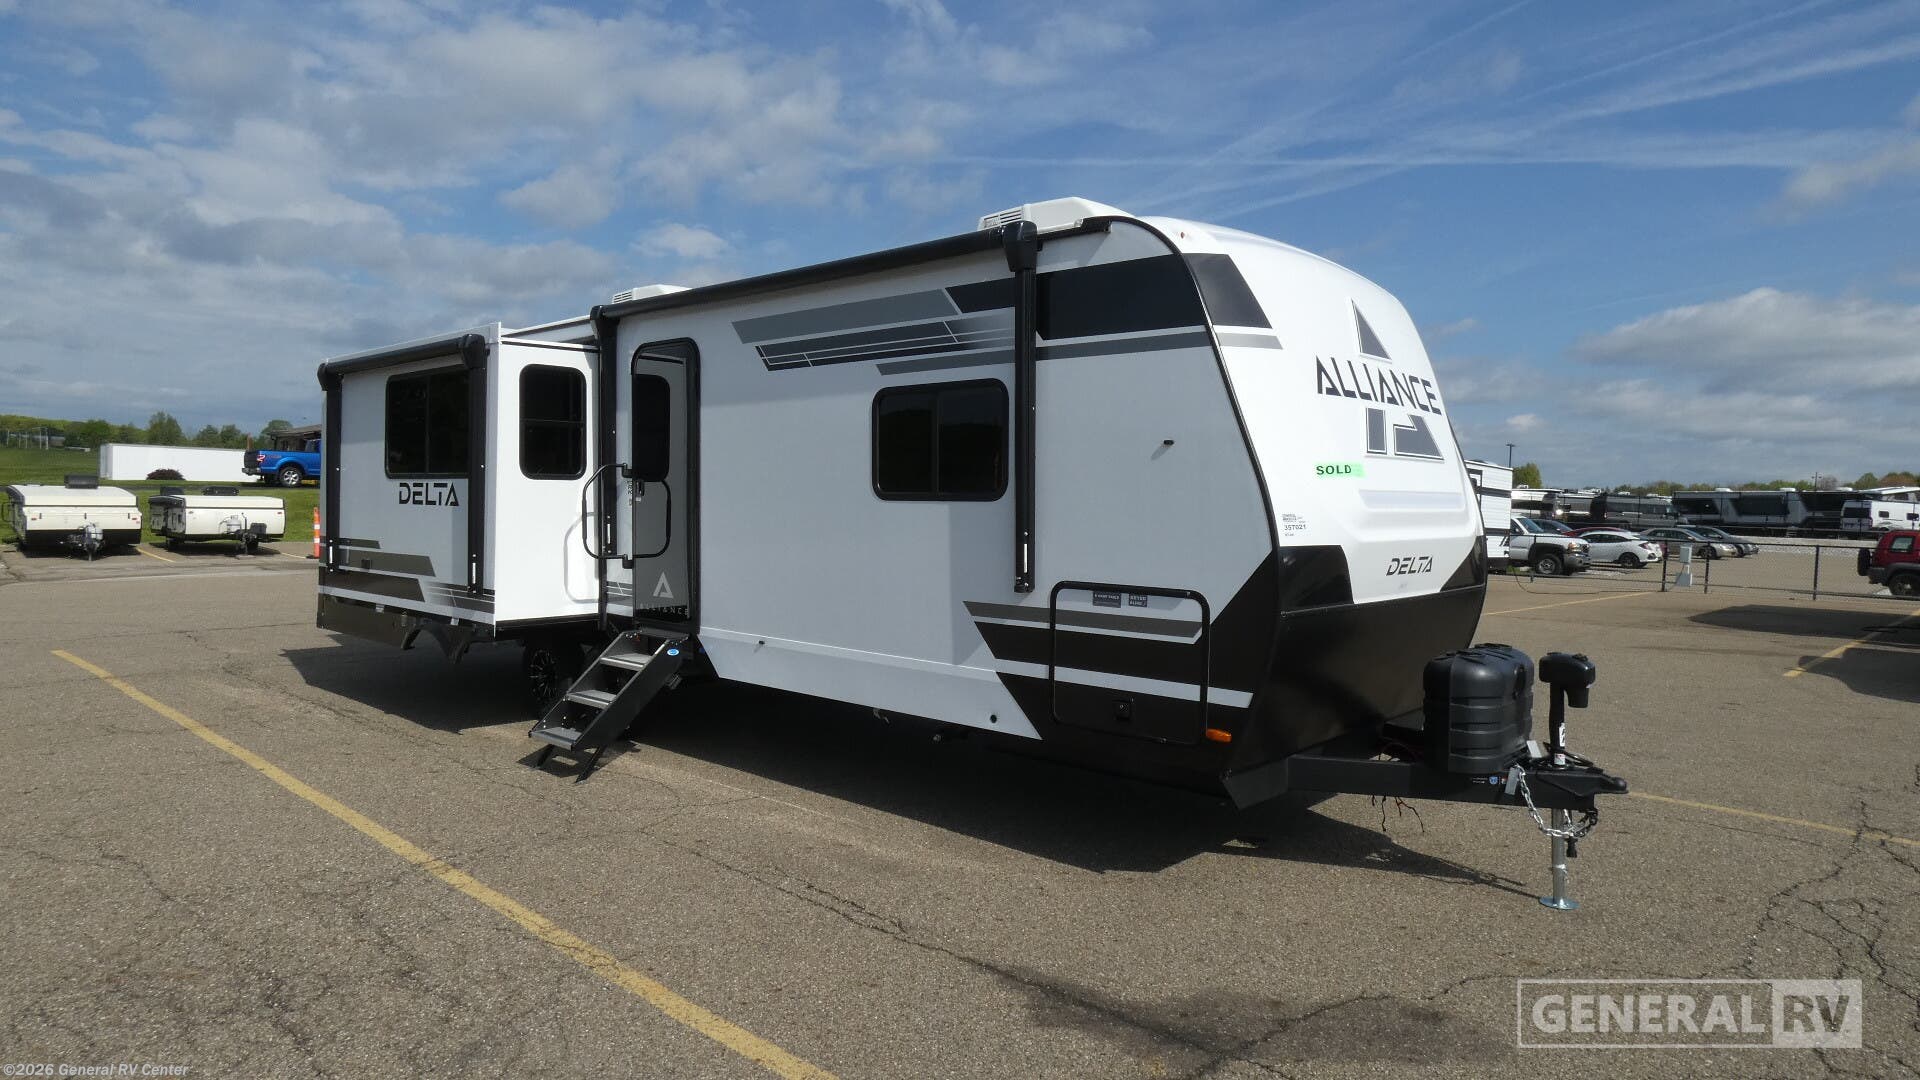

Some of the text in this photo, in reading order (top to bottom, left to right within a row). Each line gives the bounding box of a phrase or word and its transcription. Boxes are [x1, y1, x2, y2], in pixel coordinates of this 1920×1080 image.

[1316, 356, 1441, 415] ALLIANCE
[1316, 464, 1352, 476] SOLD
[399, 482, 460, 507] DELTA
[1386, 556, 1433, 577] DELTA
